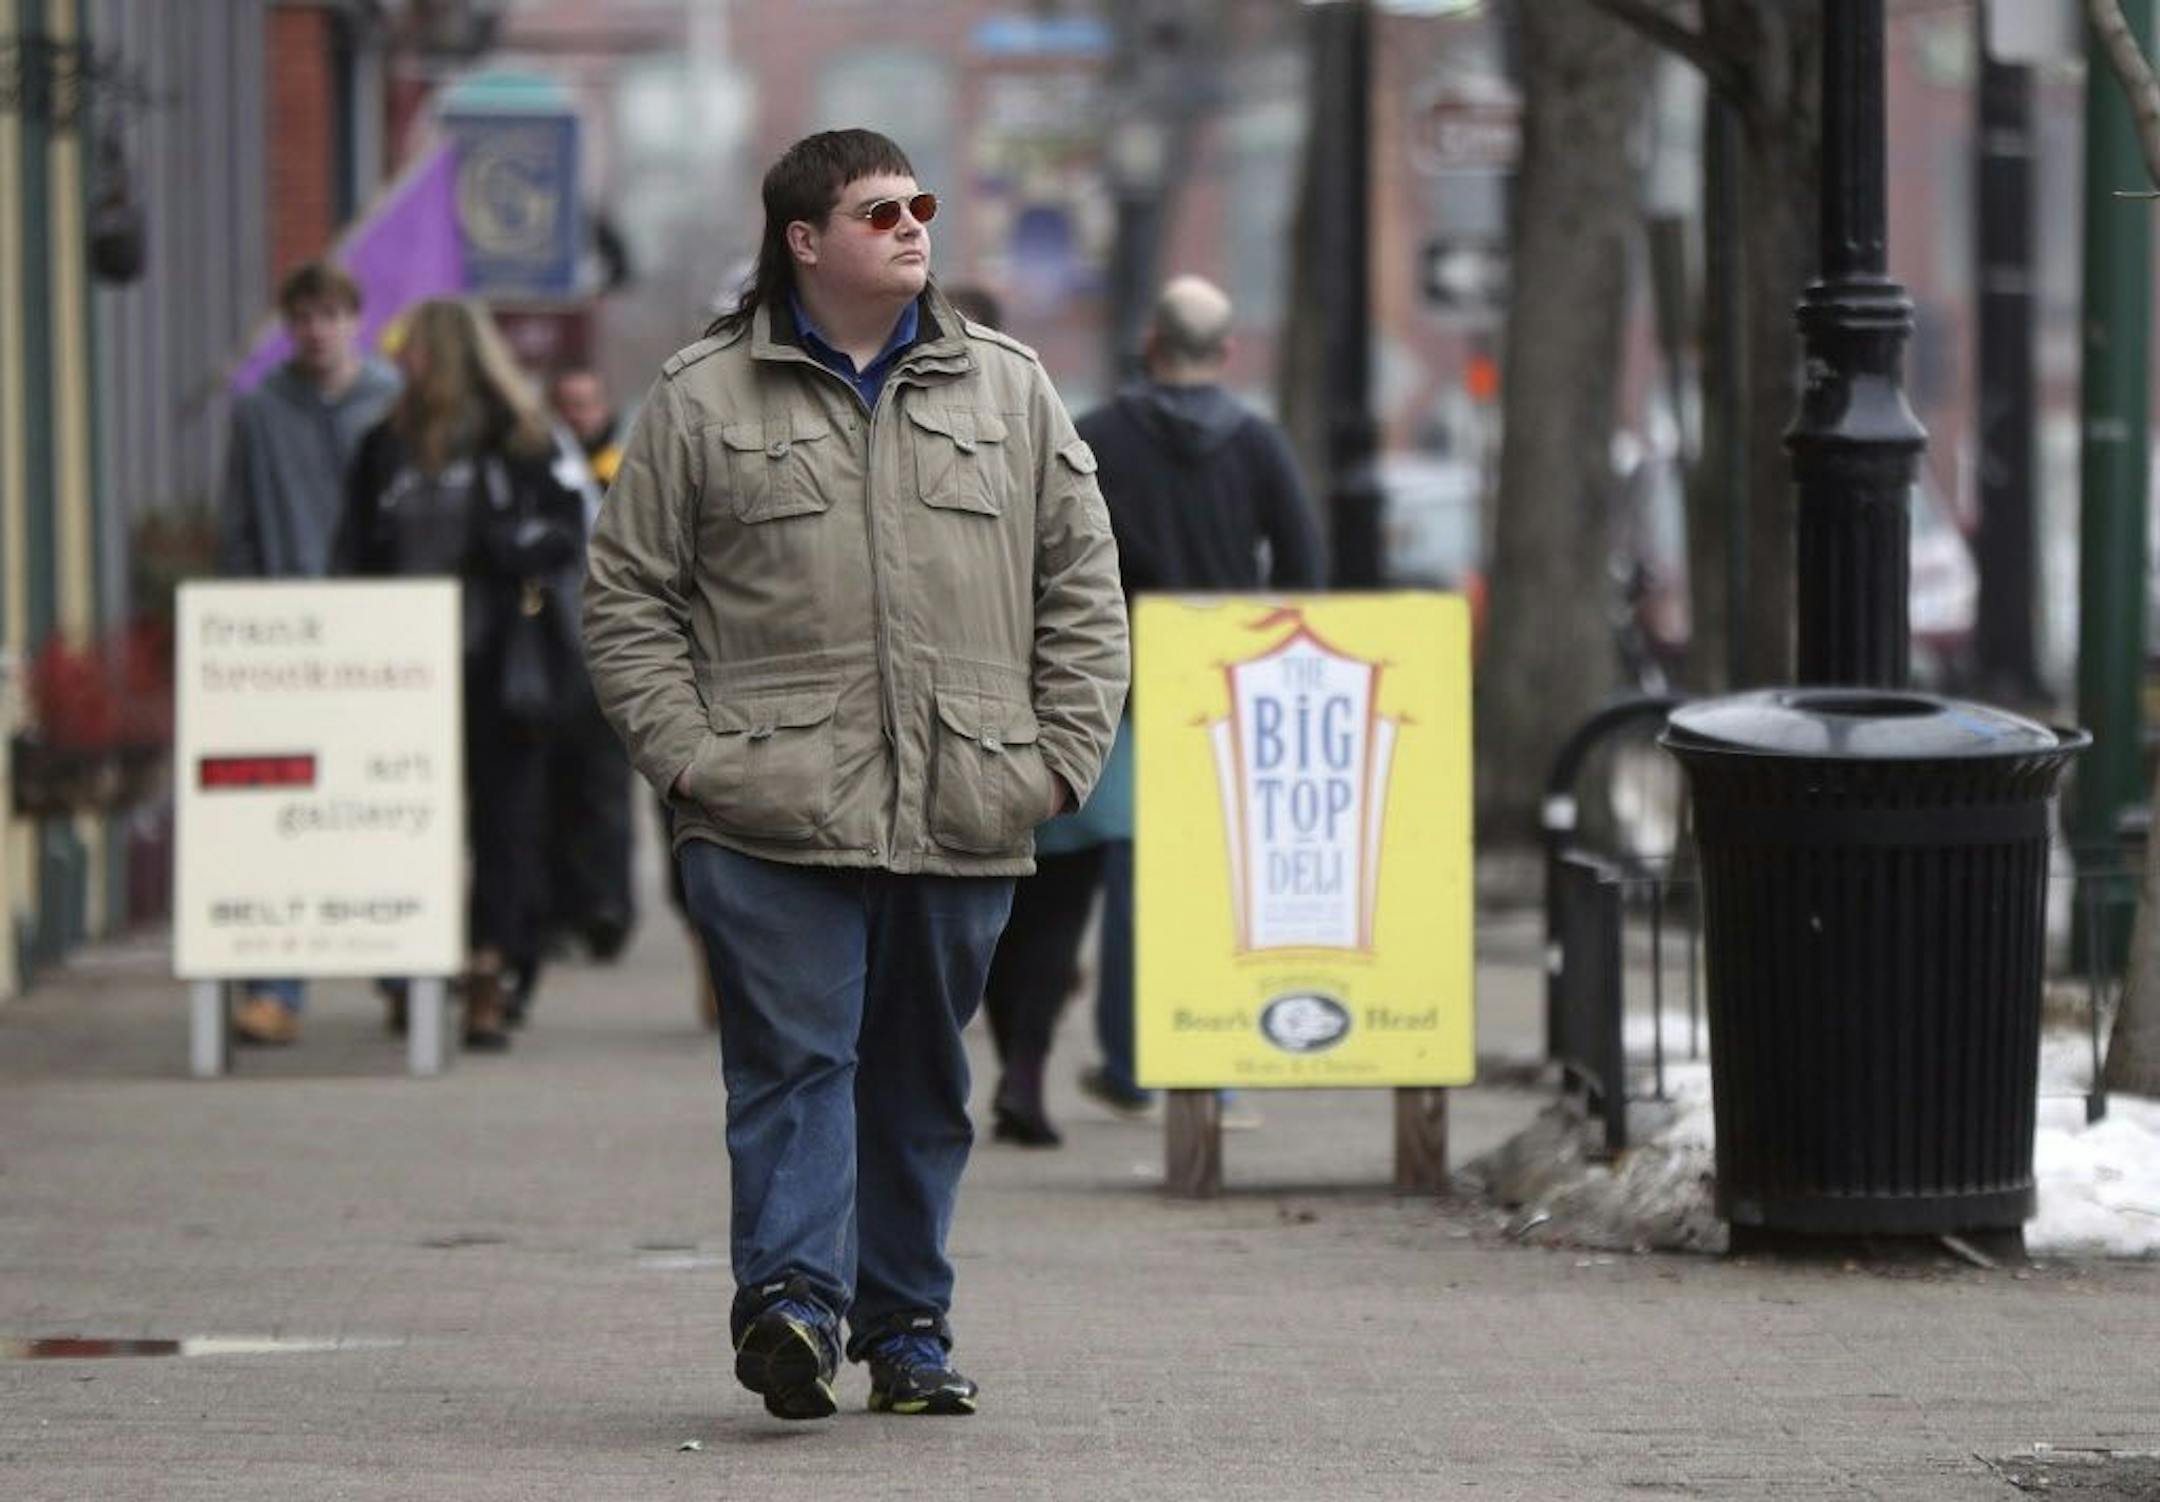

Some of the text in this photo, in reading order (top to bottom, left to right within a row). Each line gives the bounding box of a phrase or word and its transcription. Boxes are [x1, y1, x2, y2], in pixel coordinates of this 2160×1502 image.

[1282, 656, 1326, 691] THE
[276, 802, 434, 839] gallery
[1256, 778, 1352, 840] TOP
[1267, 850, 1343, 896] DELI
[209, 895, 422, 925] BELT SHOP
[1366, 1006, 1439, 1030] Head
